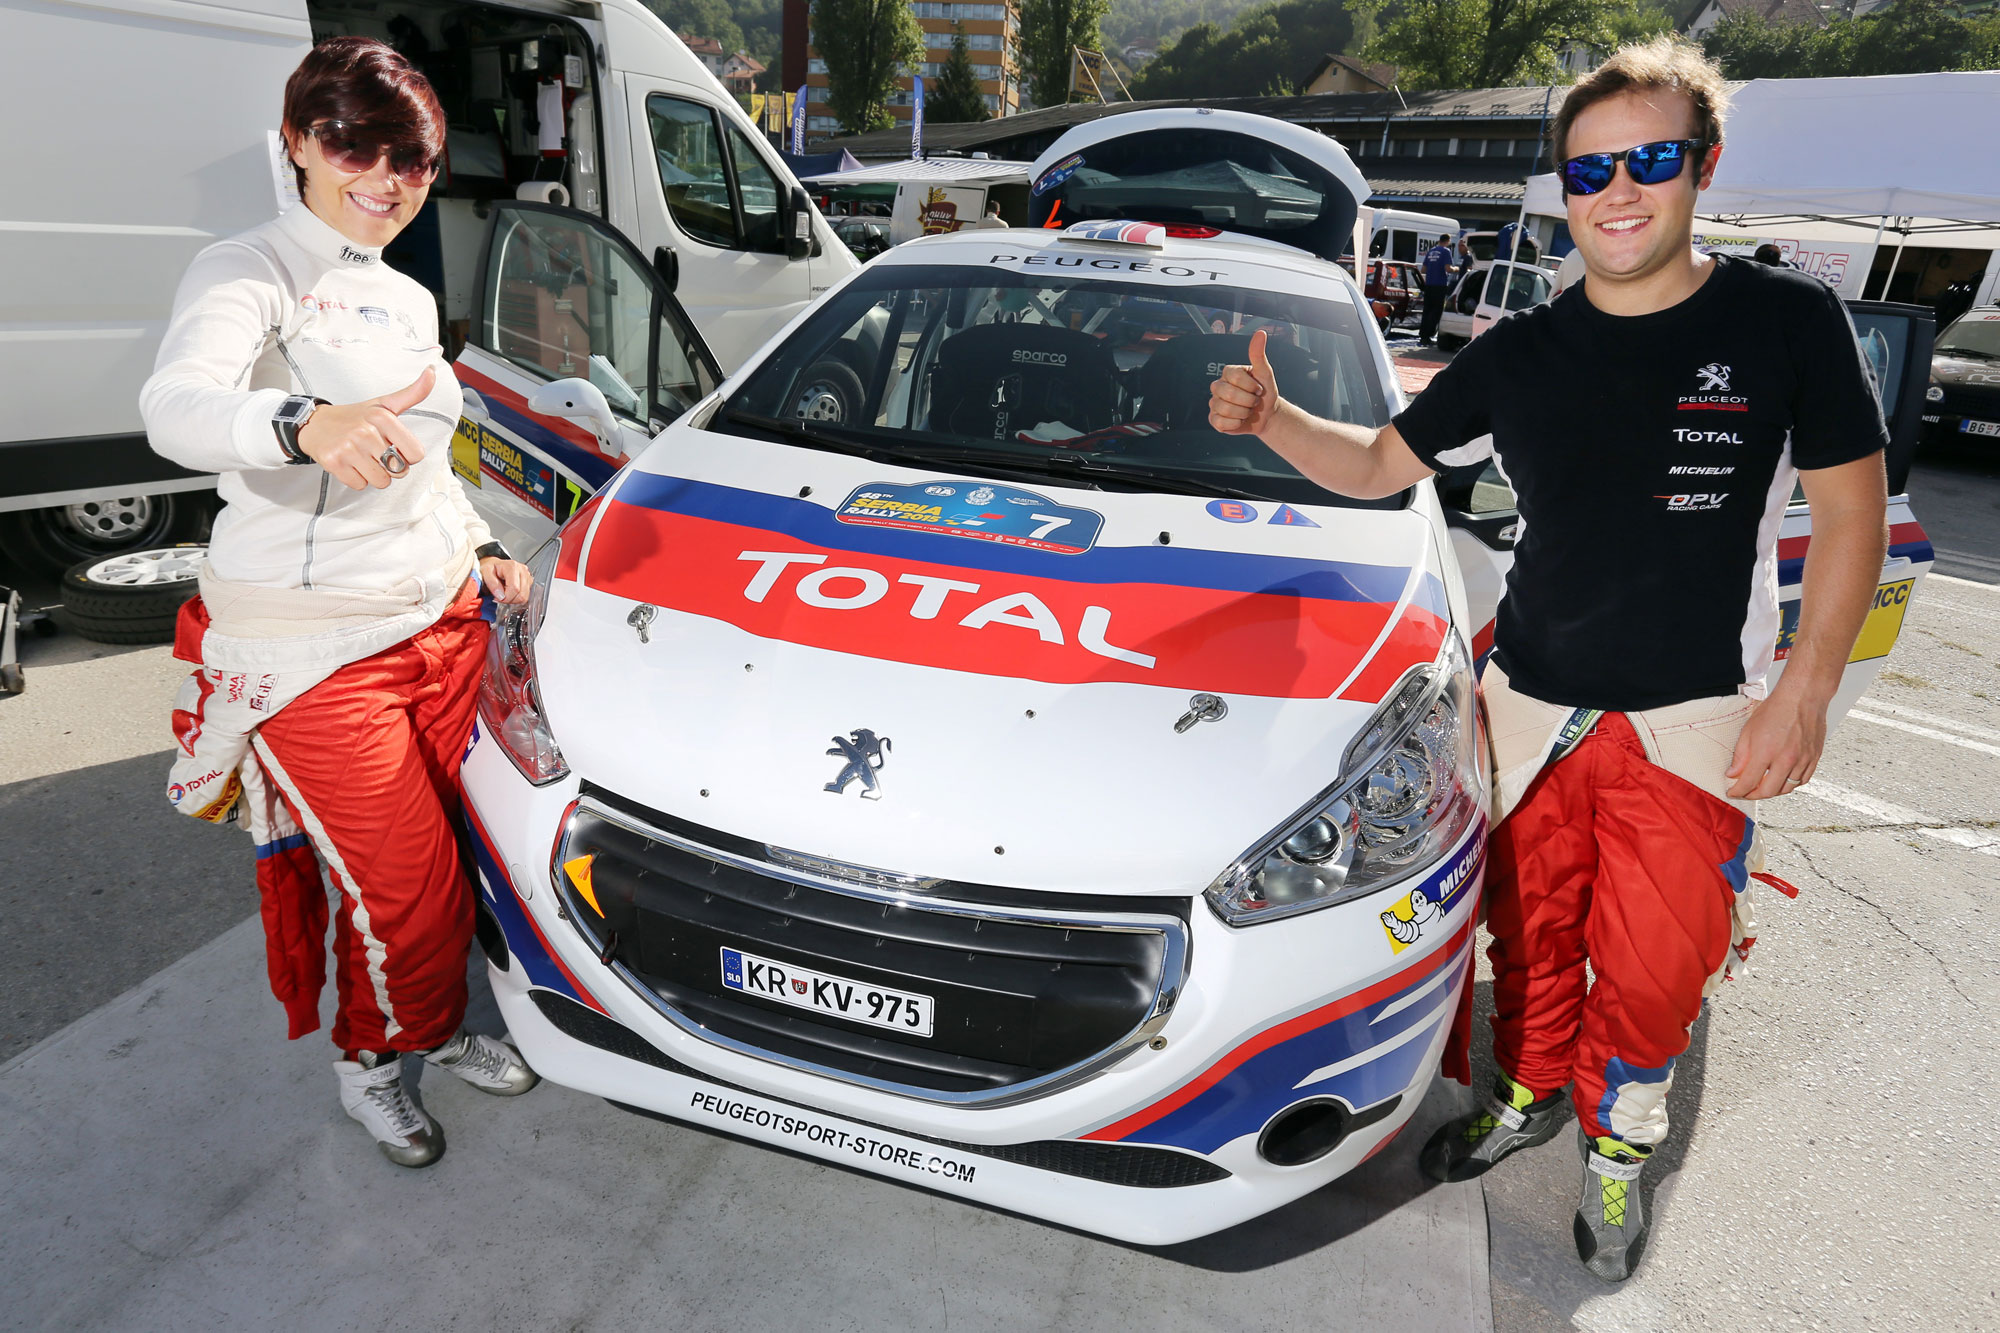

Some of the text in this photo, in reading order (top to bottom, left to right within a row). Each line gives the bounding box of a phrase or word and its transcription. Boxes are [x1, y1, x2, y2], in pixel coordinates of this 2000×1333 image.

[989, 255, 1229, 281] PEUGEOT
[1012, 349, 1067, 365] sparco
[1678, 396, 1749, 404] PEUGEOT
[1672, 428, 1744, 444] TOTAL
[480, 431, 523, 472] SERBIA
[480, 448, 524, 486] RALLY 2015
[1668, 466, 1735, 475] MICHELIN
[843, 506, 942, 523] RALLY 2015
[850, 498, 943, 516] SERBIA
[1220, 503, 1245, 519] E
[1028, 513, 1072, 540] 7
[737, 551, 1157, 669] TOTAL
[185, 769, 224, 793] TOTAL
[726, 960, 920, 1027] SLO KR KV-975
[690, 1091, 976, 1183] PEUGEOTSPORT-STORE.COM
